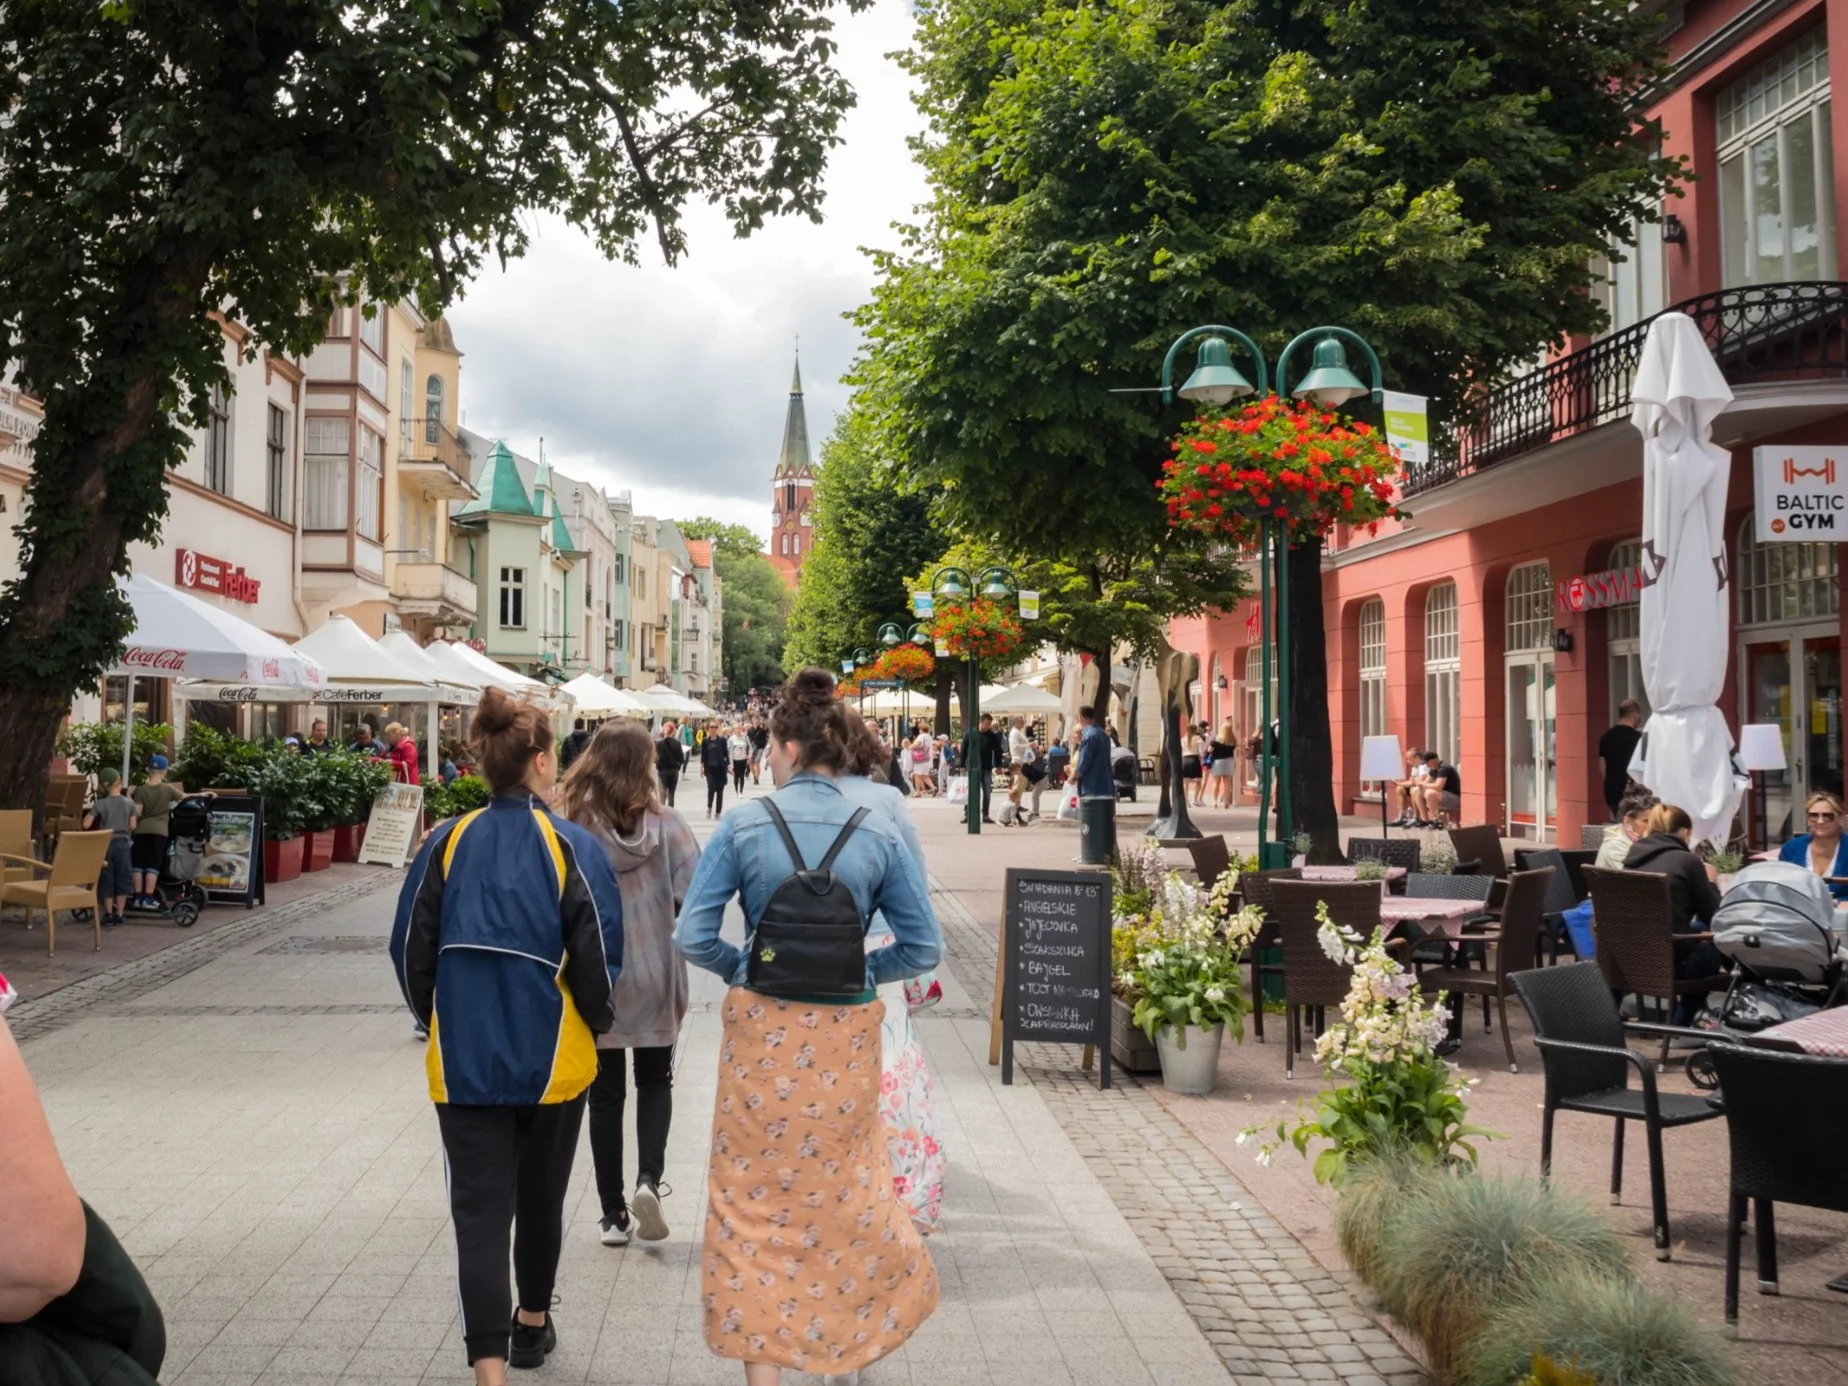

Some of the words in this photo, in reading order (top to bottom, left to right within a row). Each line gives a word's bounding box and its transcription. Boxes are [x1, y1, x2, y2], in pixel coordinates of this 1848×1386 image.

[1777, 494, 1844, 510] BALTIC
[1789, 513, 1834, 529] GYM
[322, 689, 383, 701] CafeFerber
